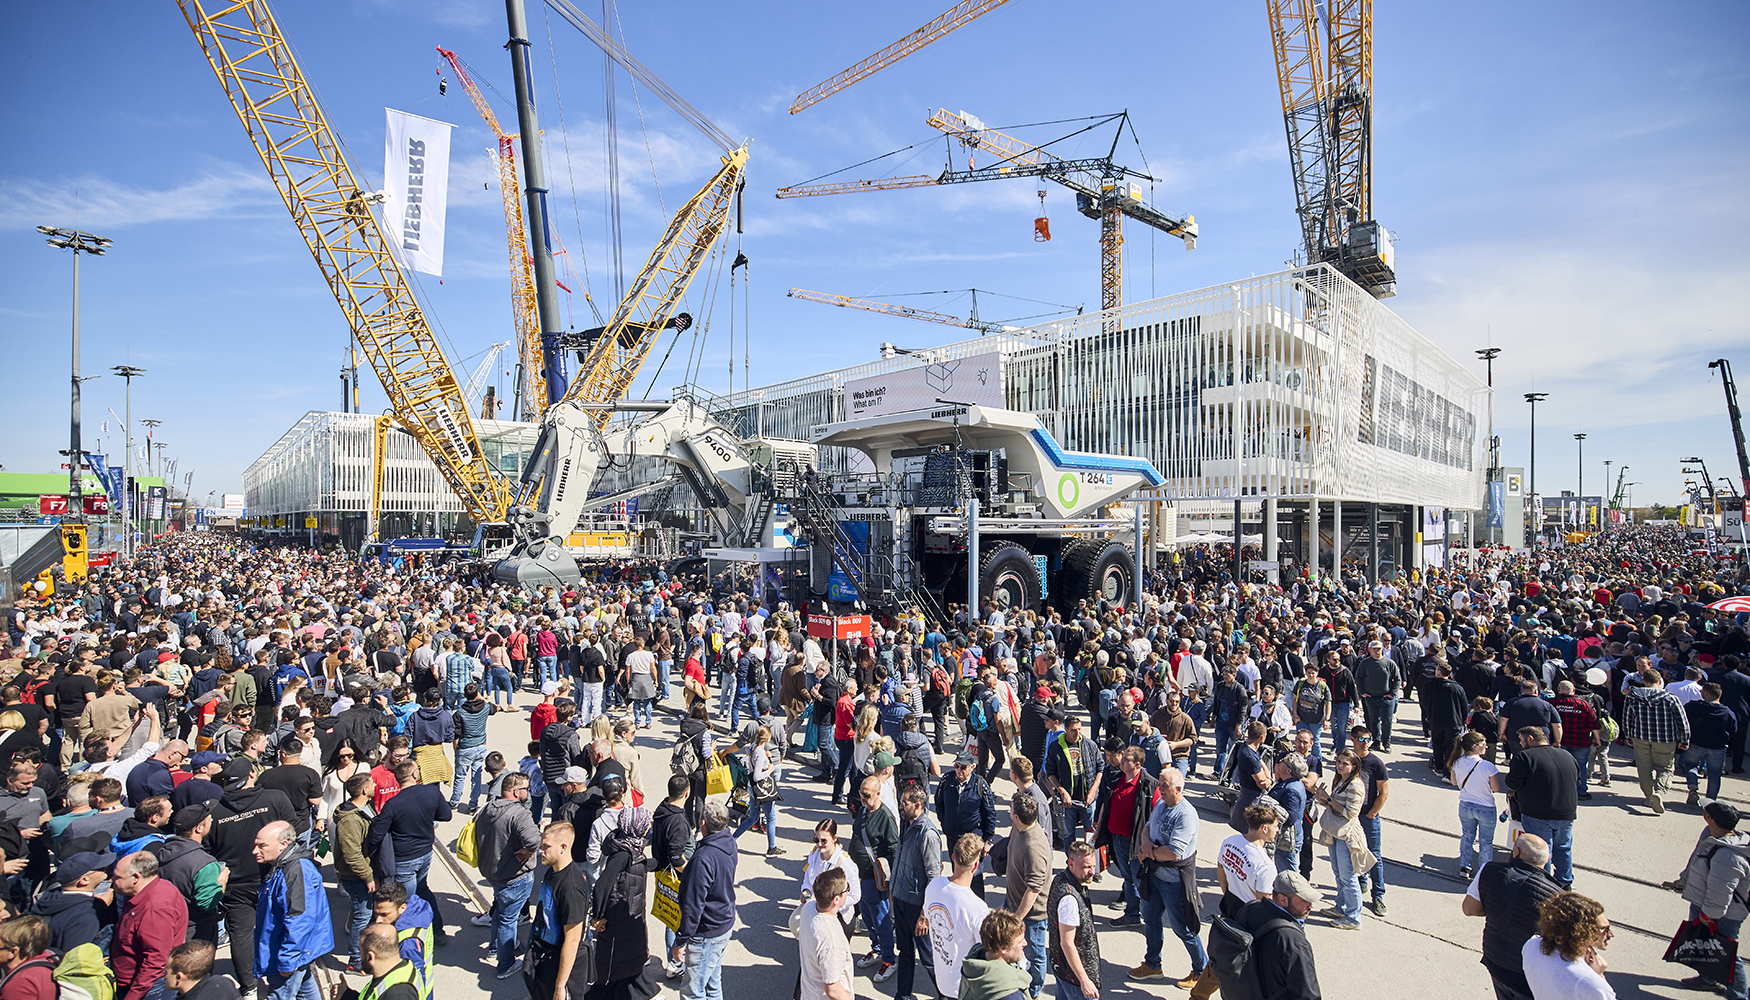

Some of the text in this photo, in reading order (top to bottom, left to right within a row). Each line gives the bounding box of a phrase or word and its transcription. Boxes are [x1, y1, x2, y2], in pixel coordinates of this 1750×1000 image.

[852, 386, 887, 400] Was bin ich?
[853, 399, 868, 409] What
[931, 408, 967, 419] LIEBHERR
[440, 409, 470, 459] LIEBHERR
[704, 435, 732, 462] 9400
[556, 458, 572, 502] LIEBHERR
[1080, 472, 1085, 483] T
[1087, 472, 1105, 484] 264
[50, 501, 67, 510] F7
[93, 501, 108, 510] F8
[850, 513, 887, 521] LIEBHERR
[1726, 517, 1741, 526] SÜ
[317, 679, 326, 687] PE
